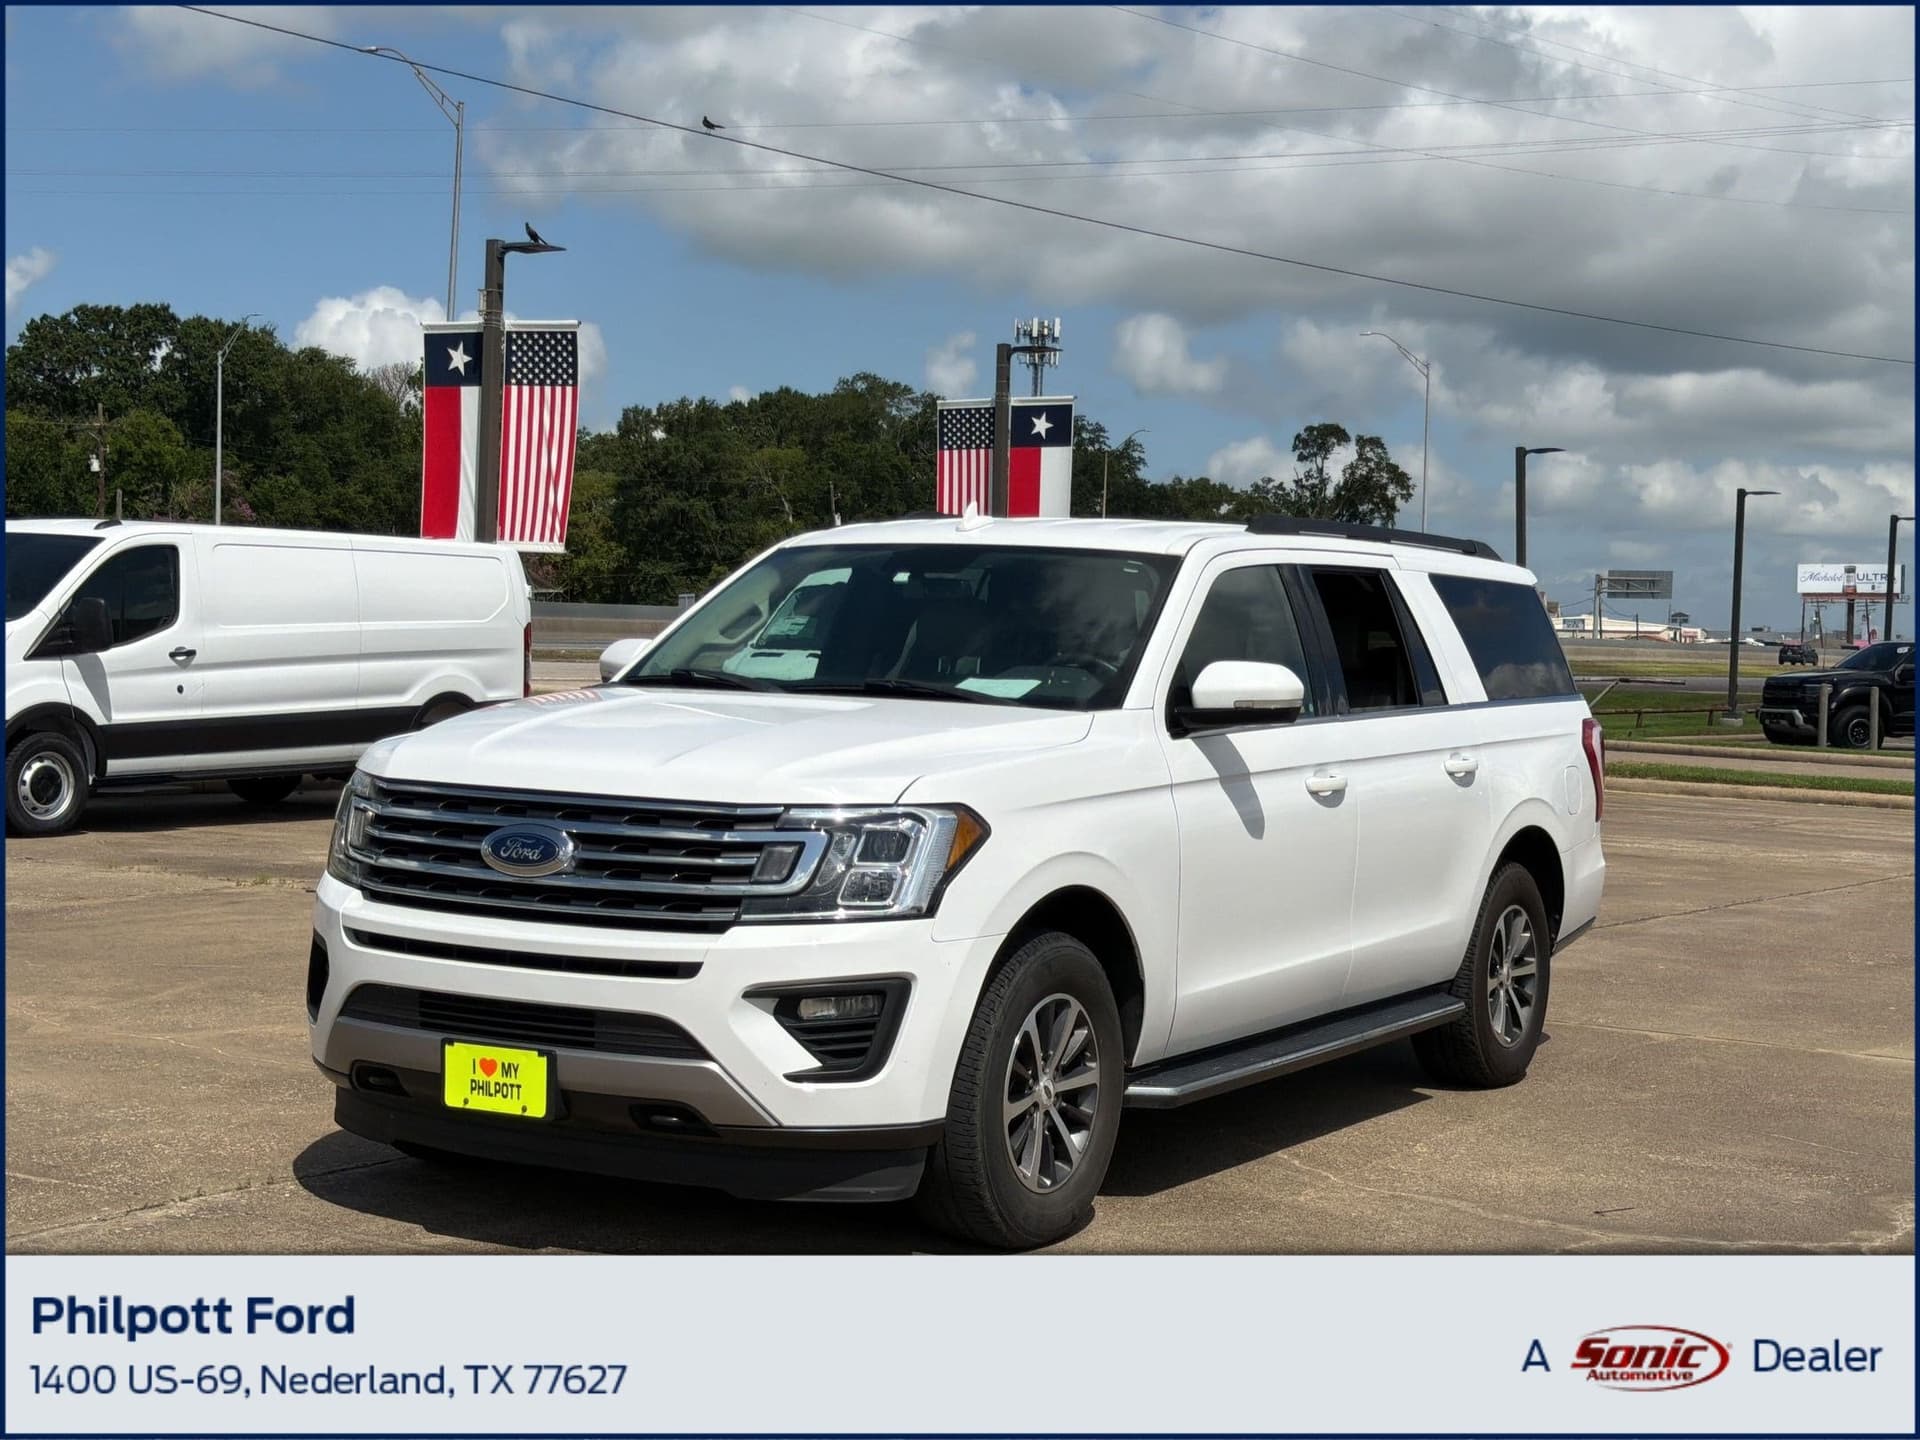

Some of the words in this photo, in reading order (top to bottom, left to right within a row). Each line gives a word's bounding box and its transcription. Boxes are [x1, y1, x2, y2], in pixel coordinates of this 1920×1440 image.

[1856, 572, 1896, 582] ULTR
[500, 837, 546, 861] Ford
[472, 1058, 476, 1075] I
[501, 1061, 520, 1080] MY
[470, 1079, 522, 1101] PHILPOTT
